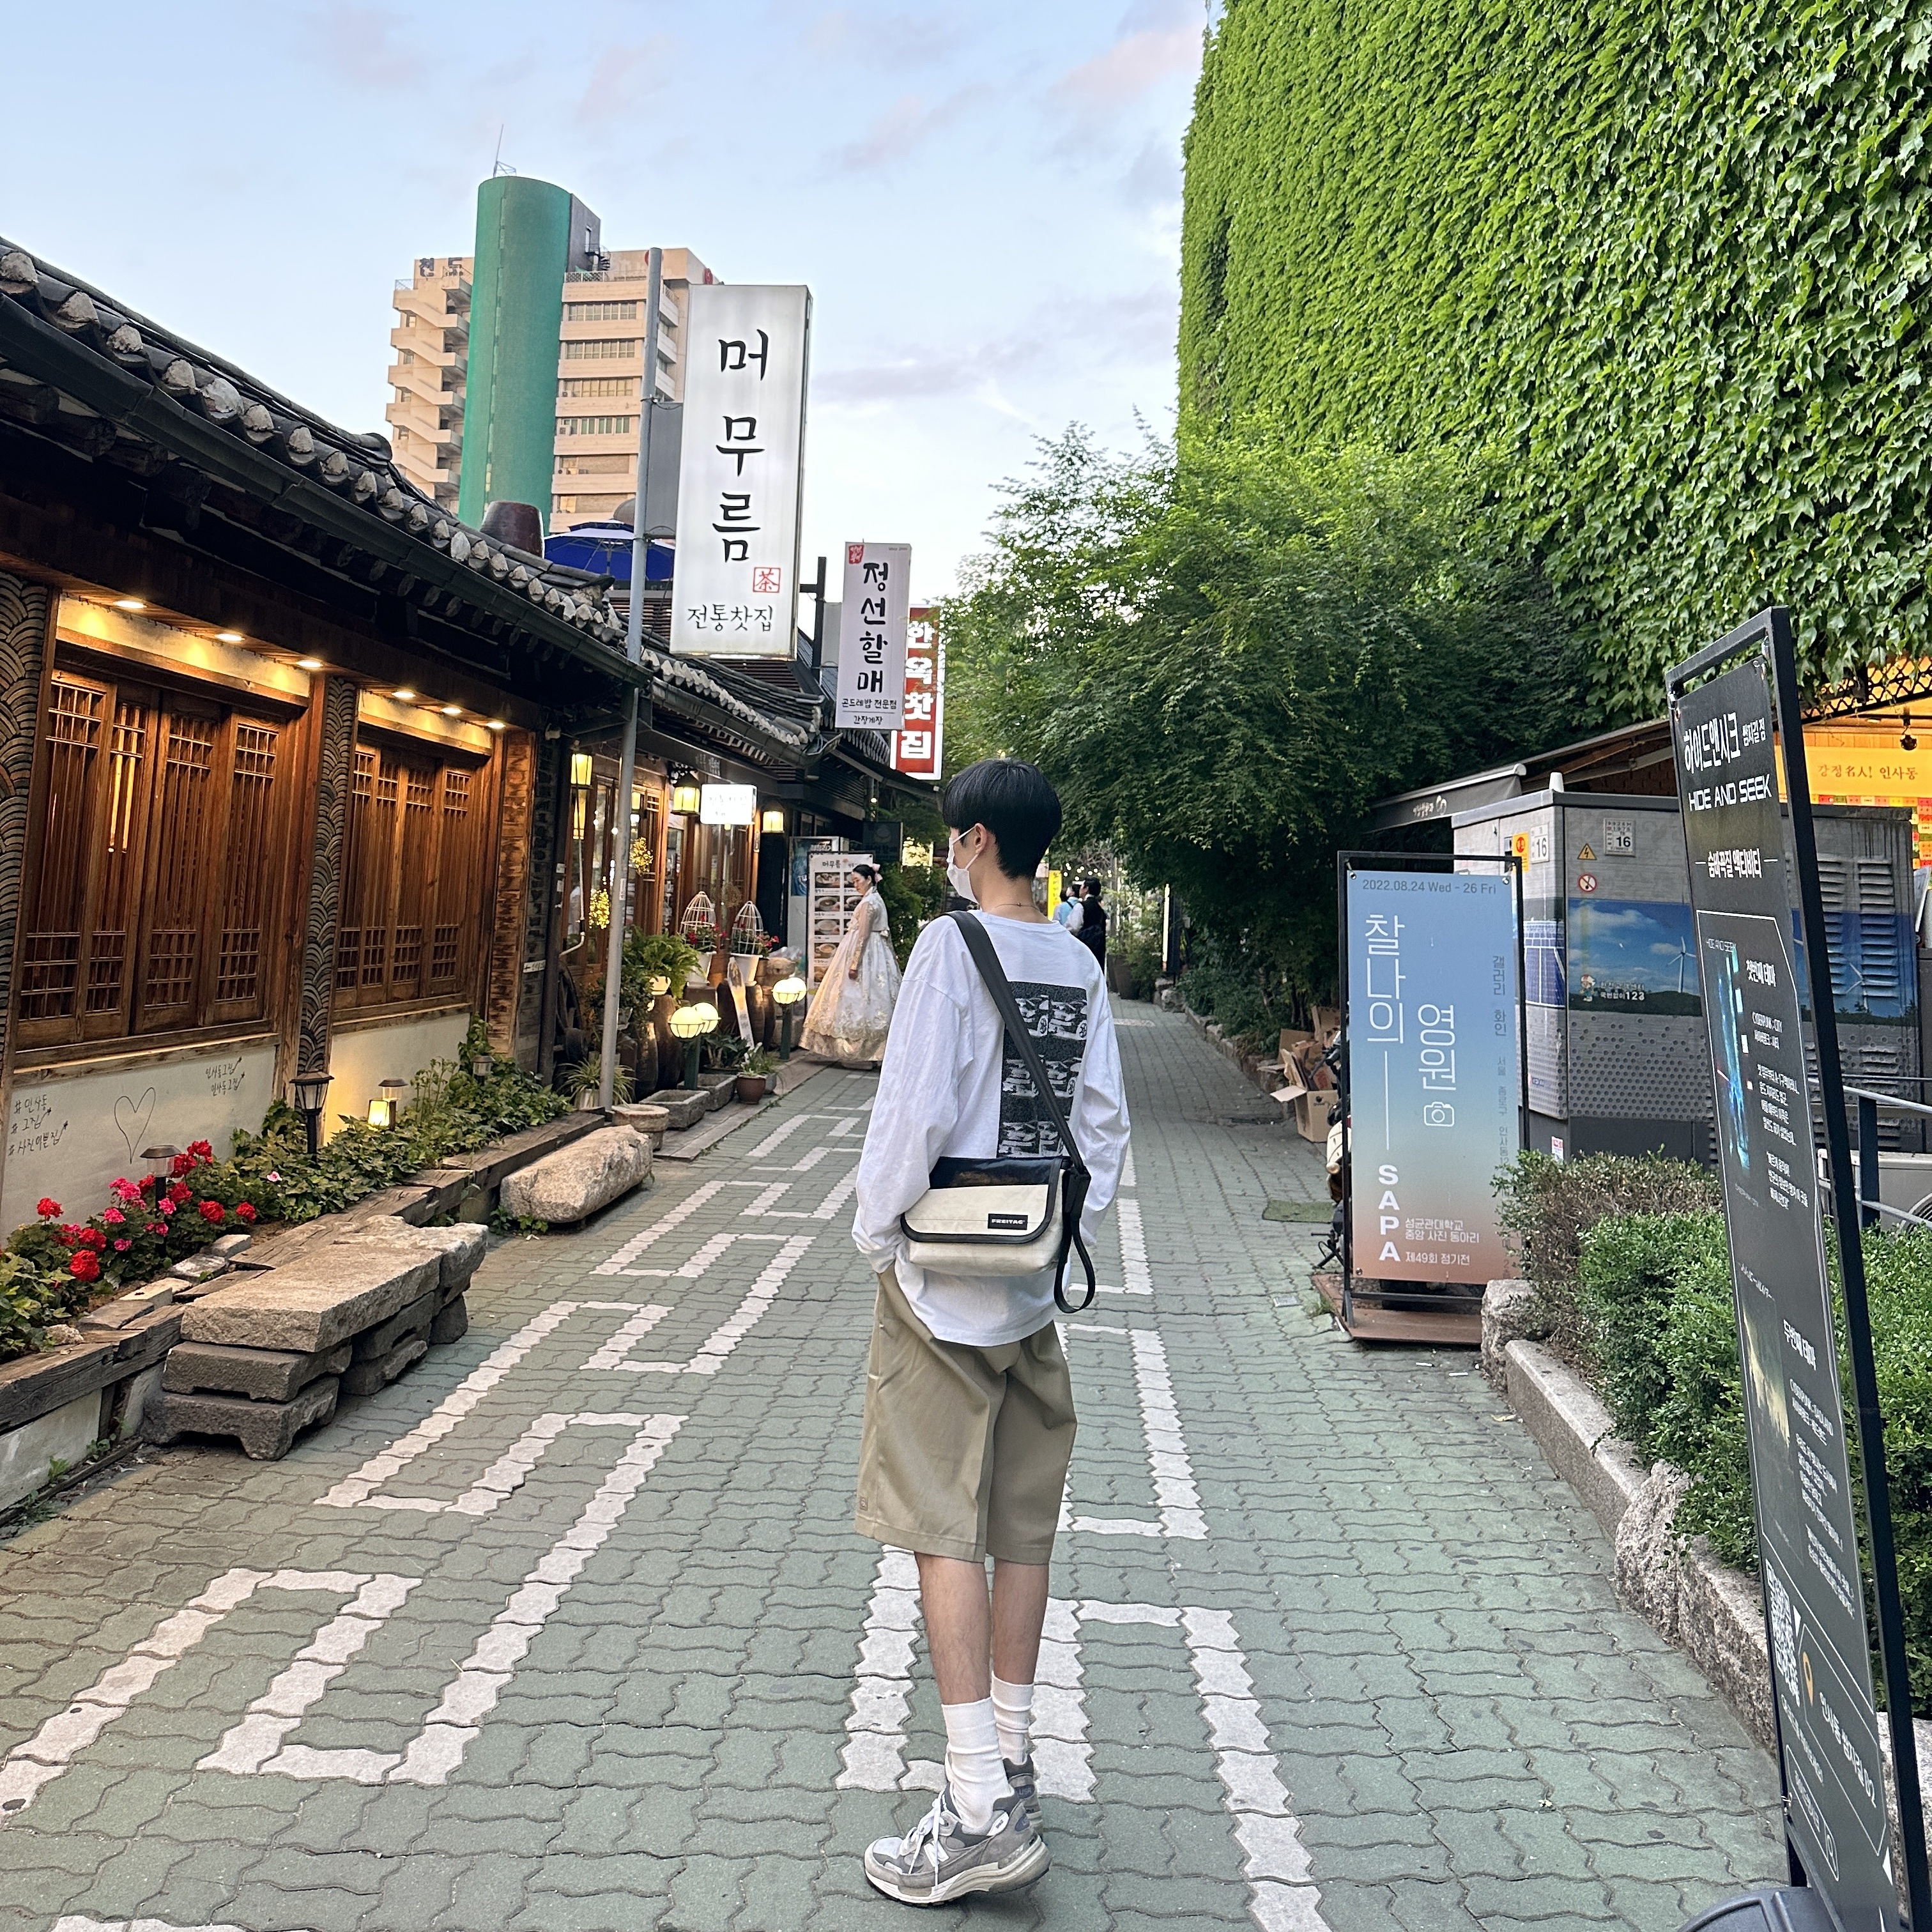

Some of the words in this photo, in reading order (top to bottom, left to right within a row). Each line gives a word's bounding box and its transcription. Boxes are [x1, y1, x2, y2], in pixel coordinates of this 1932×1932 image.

[712, 329, 770, 563] 머무름
[757, 571, 778, 593] 茶
[687, 604, 774, 632] 전통찻집
[857, 562, 889, 693] 정선할매
[841, 698, 872, 709] 곤드레밥
[874, 700, 897, 709] 전문점
[854, 716, 883, 725] 간장게장
[1682, 712, 1740, 773] 하이드앤시크
[1879, 765, 1919, 780] 인사동
[1687, 788, 1712, 811] HIDE
[1713, 782, 1736, 808] AND
[1738, 773, 1772, 802] SEEK
[1536, 837, 1547, 857] 16
[1616, 836, 1631, 847] 16
[1707, 850, 1733, 878] 숨바꼭질
[1731, 848, 1762, 878] 액티비티
[1362, 880, 1425, 891] 2022.08.24
[1428, 882, 1452, 893] Wed
[1463, 883, 1477, 893] 26
[1481, 884, 1496, 894] Fri
[1364, 914, 1405, 1044] 찰나의
[1492, 955, 1506, 995] 갤러리
[1625, 991, 1645, 1001] 123
[1494, 1009, 1507, 1036] 화인
[1417, 1003, 1457, 1091] 영원
[1405, 1217, 1464, 1231] 성균관대학교
[1405, 1229, 1425, 1241] 중앙
[1427, 1230, 1448, 1242] 사진
[1450, 1231, 1480, 1244] 동아리
[1405, 1251, 1438, 1264] 제49회
[1441, 1253, 1471, 1266] 정기전
[1819, 1692, 1841, 1744] 인사동
